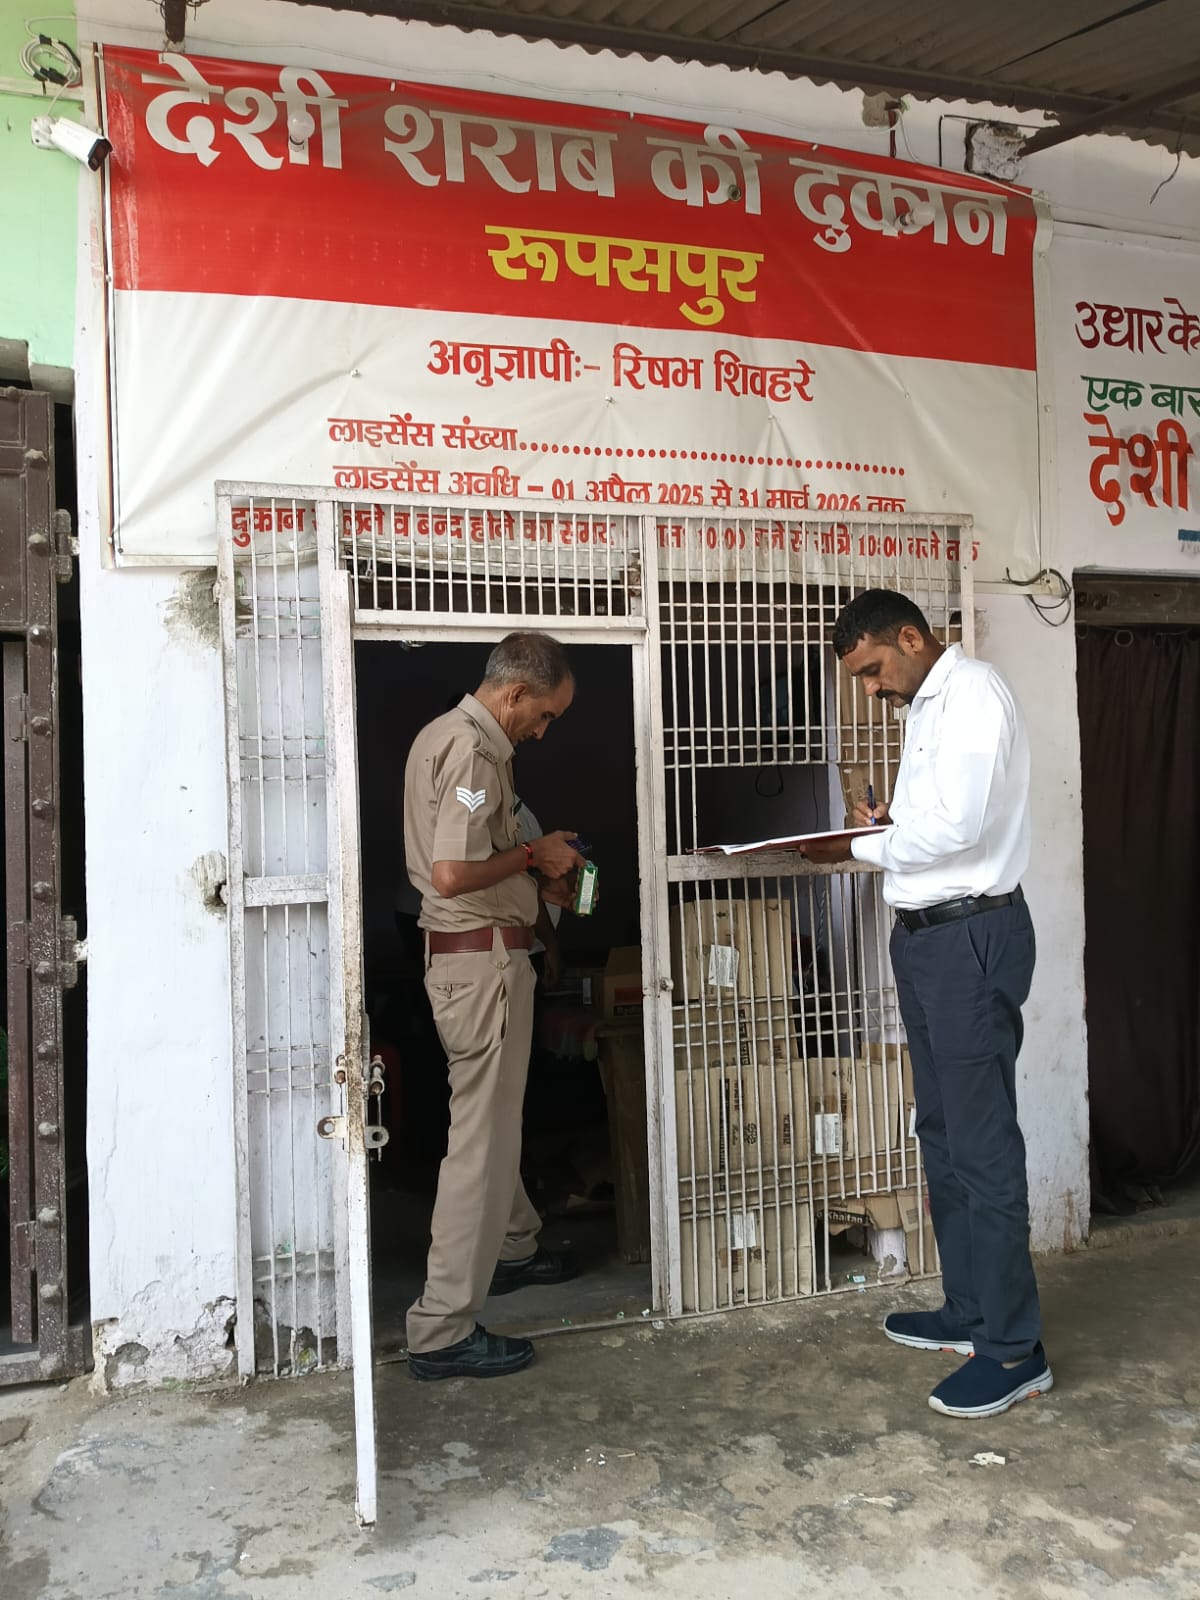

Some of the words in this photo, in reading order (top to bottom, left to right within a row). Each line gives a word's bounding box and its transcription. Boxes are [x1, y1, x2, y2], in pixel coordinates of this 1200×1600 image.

[141, 52, 349, 171] देशी
[383, 103, 618, 198] शराब
[646, 124, 763, 215] की
[788, 157, 1009, 256] दुकान
[484, 224, 765, 325] रूपसपुर
[1074, 301, 1168, 355] उधार
[612, 342, 704, 391] रिषभ
[714, 348, 816, 402] शिवहरे
[1080, 375, 1145, 412] एक
[327, 412, 435, 448] लाइसेंस
[448, 465, 521, 498] अवधि
[551, 478, 574, 500] 01
[657, 482, 704, 505] 2025
[710, 478, 733, 507] से
[738, 487, 759, 508] 31
[766, 483, 810, 510] मार्च
[816, 492, 860, 511] 2026
[1083, 412, 1194, 526] देशी
[231, 507, 306, 548] दुकान
